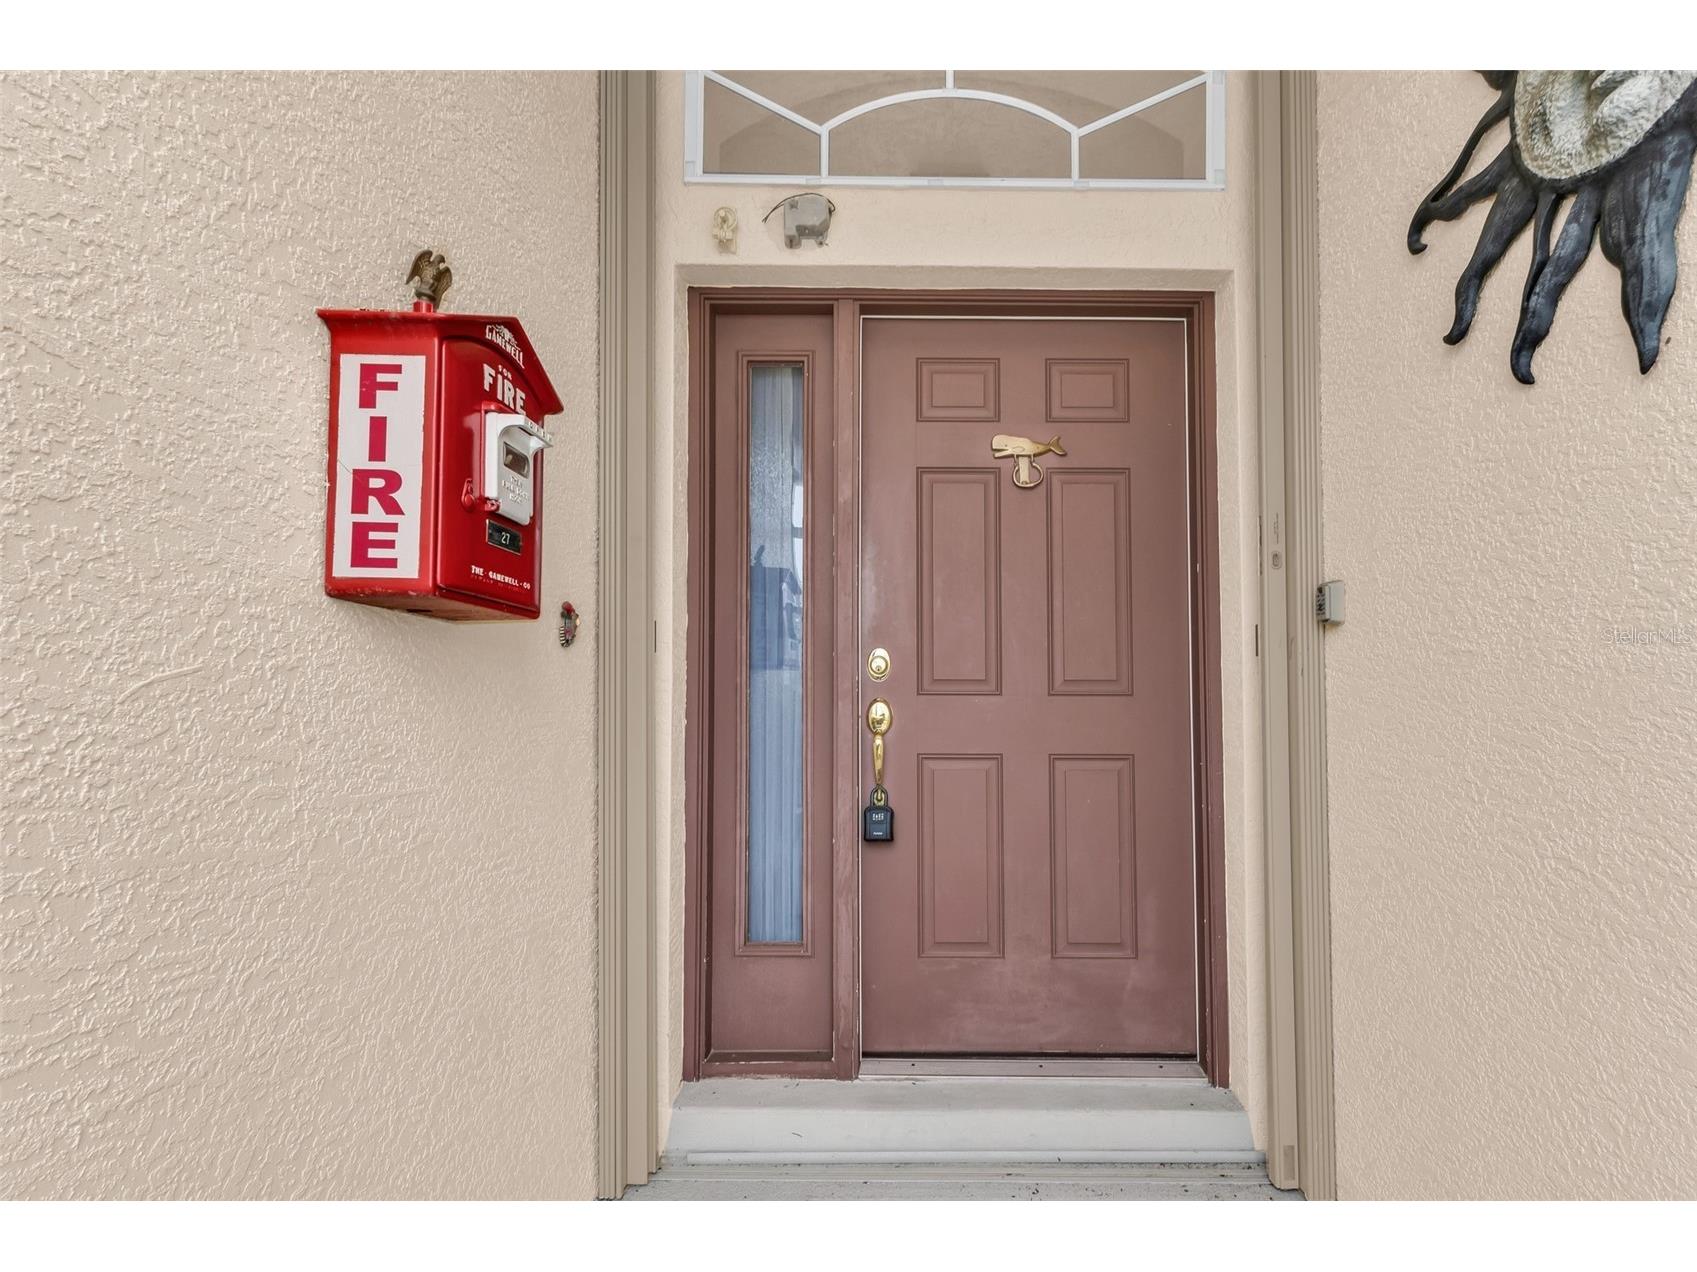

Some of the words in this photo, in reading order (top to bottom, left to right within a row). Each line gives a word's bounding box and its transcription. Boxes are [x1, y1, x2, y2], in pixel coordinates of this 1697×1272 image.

[485, 324, 525, 369] GAMEWELL
[483, 363, 526, 415] FIRE
[350, 363, 405, 569] FIRE
[501, 532, 510, 545] 27
[471, 565, 484, 576] THE
[488, 570, 519, 587] GAMEWELL
